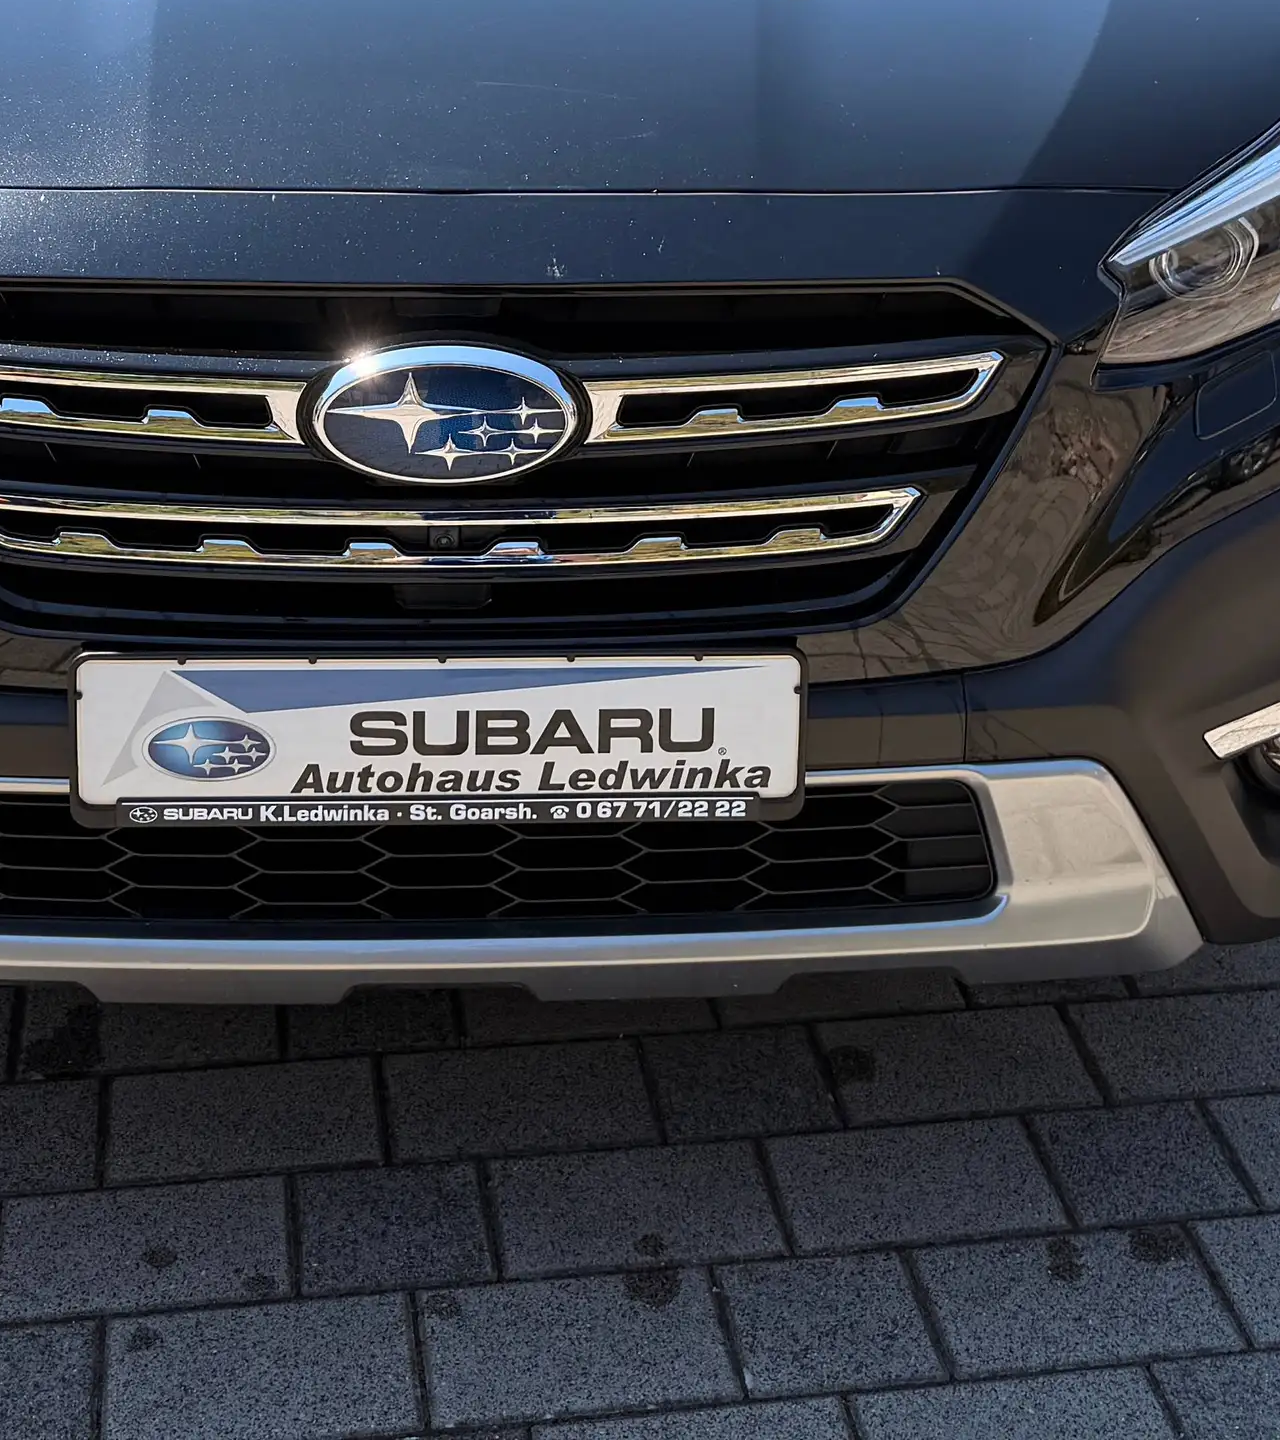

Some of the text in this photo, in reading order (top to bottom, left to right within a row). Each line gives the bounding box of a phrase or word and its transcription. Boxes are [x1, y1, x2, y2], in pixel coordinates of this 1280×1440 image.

[349, 707, 716, 757] SUBARU
[290, 758, 772, 794] Autohaus Ledwinka
[163, 806, 253, 822] SUBARU
[260, 804, 390, 823] K.Ledwinka
[409, 803, 442, 822] St.
[449, 803, 538, 821] Goarsh.
